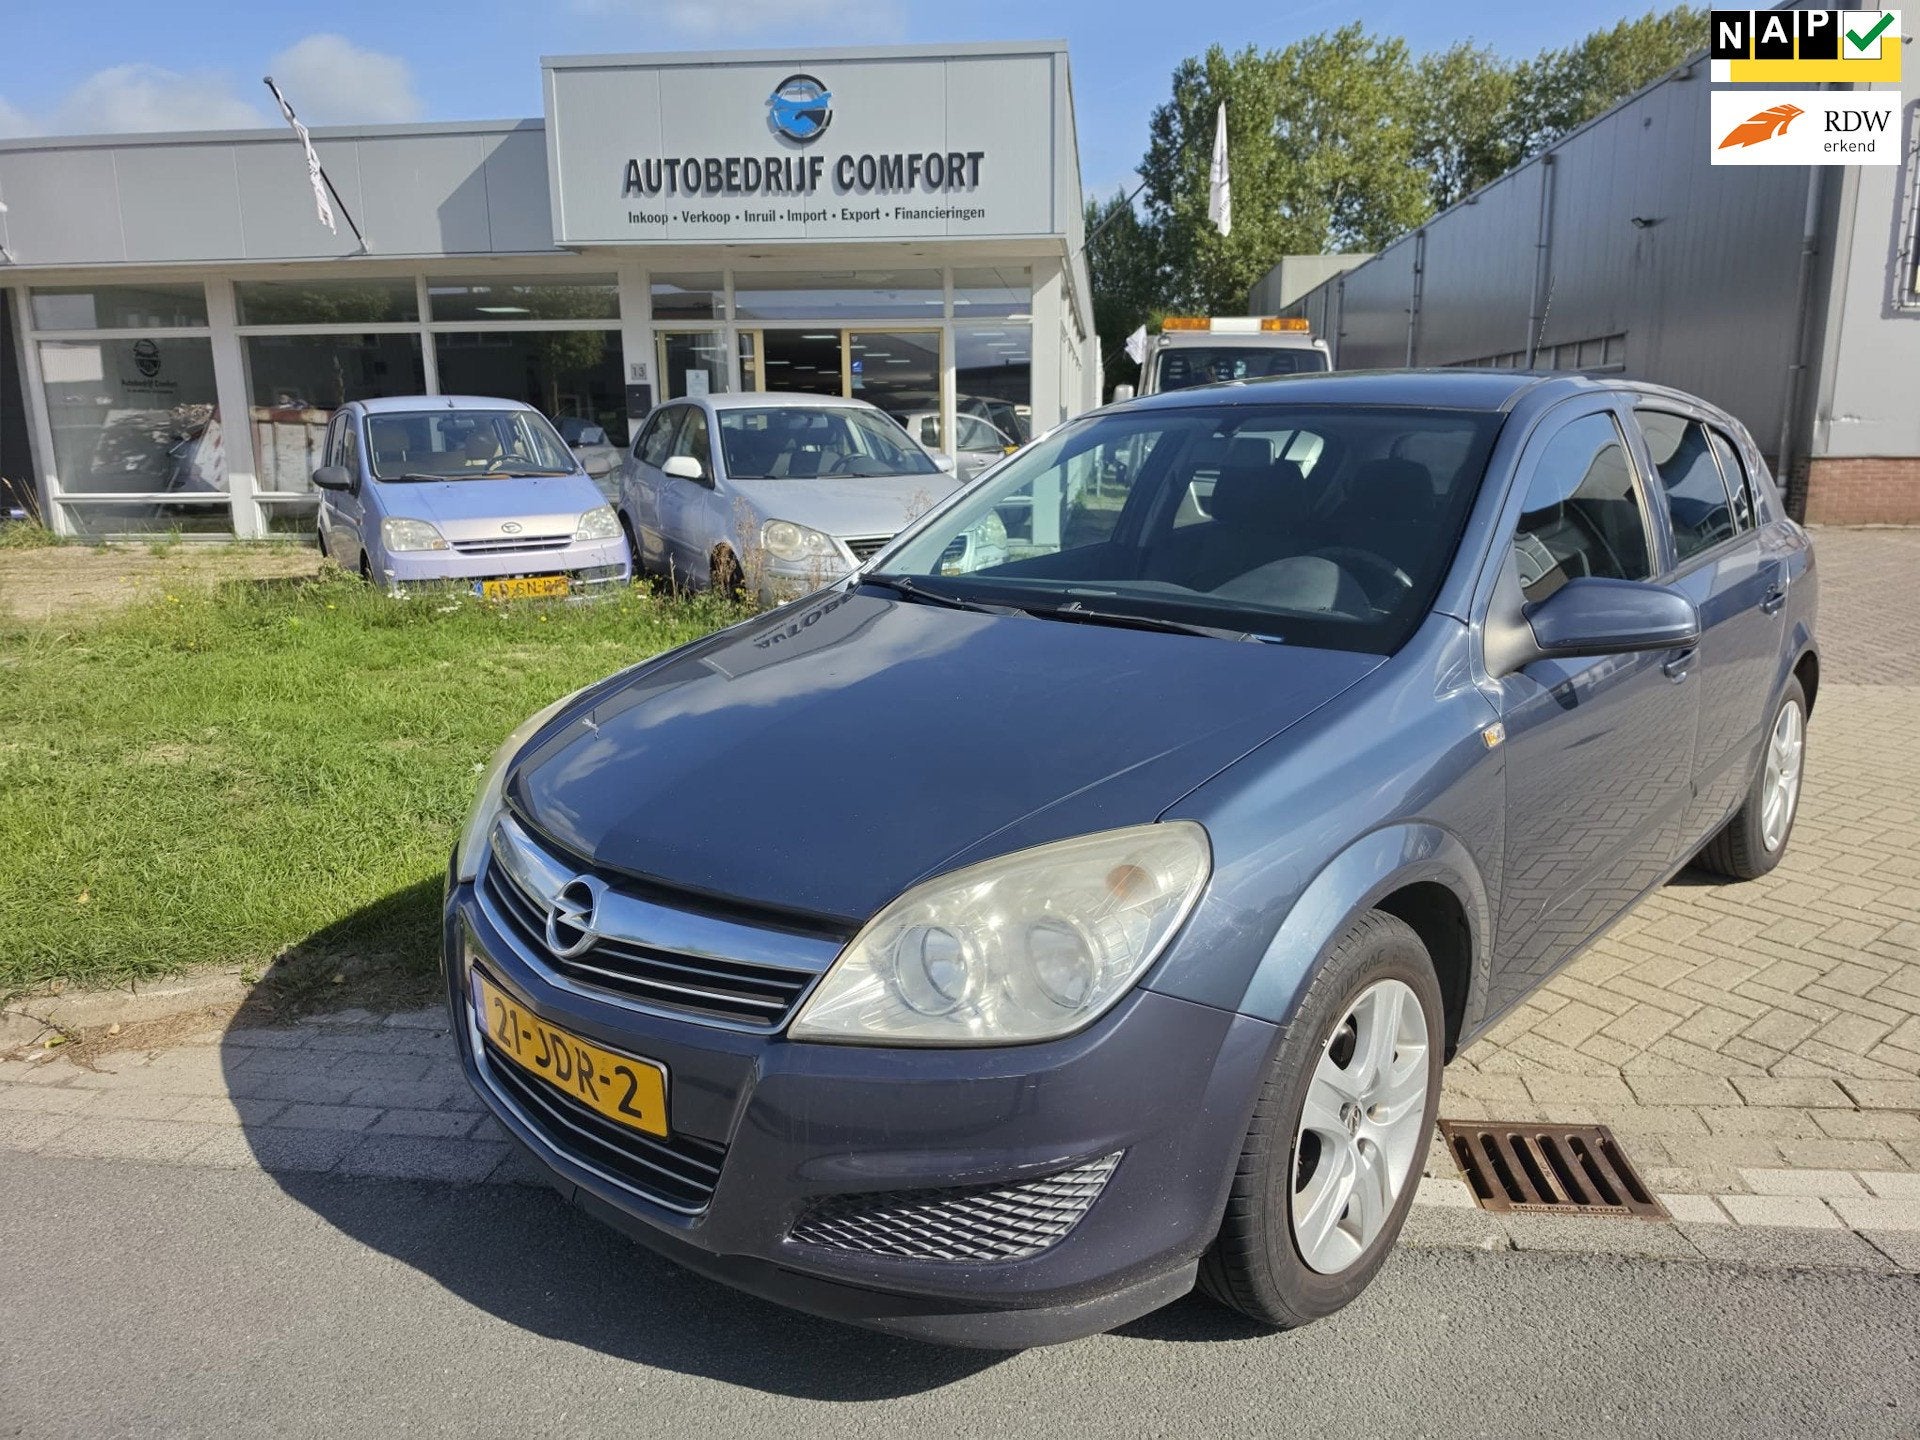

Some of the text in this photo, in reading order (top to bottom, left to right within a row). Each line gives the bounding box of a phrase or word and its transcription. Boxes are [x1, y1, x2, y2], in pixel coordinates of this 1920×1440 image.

[625, 151, 985, 193] AUTOBEDRIJF COMFORT
[628, 206, 985, 225] Inkoop Verkoop Inruil Import Export Financieringen
[632, 366, 645, 377] 13
[494, 997, 643, 1119] 21-JDR-2
